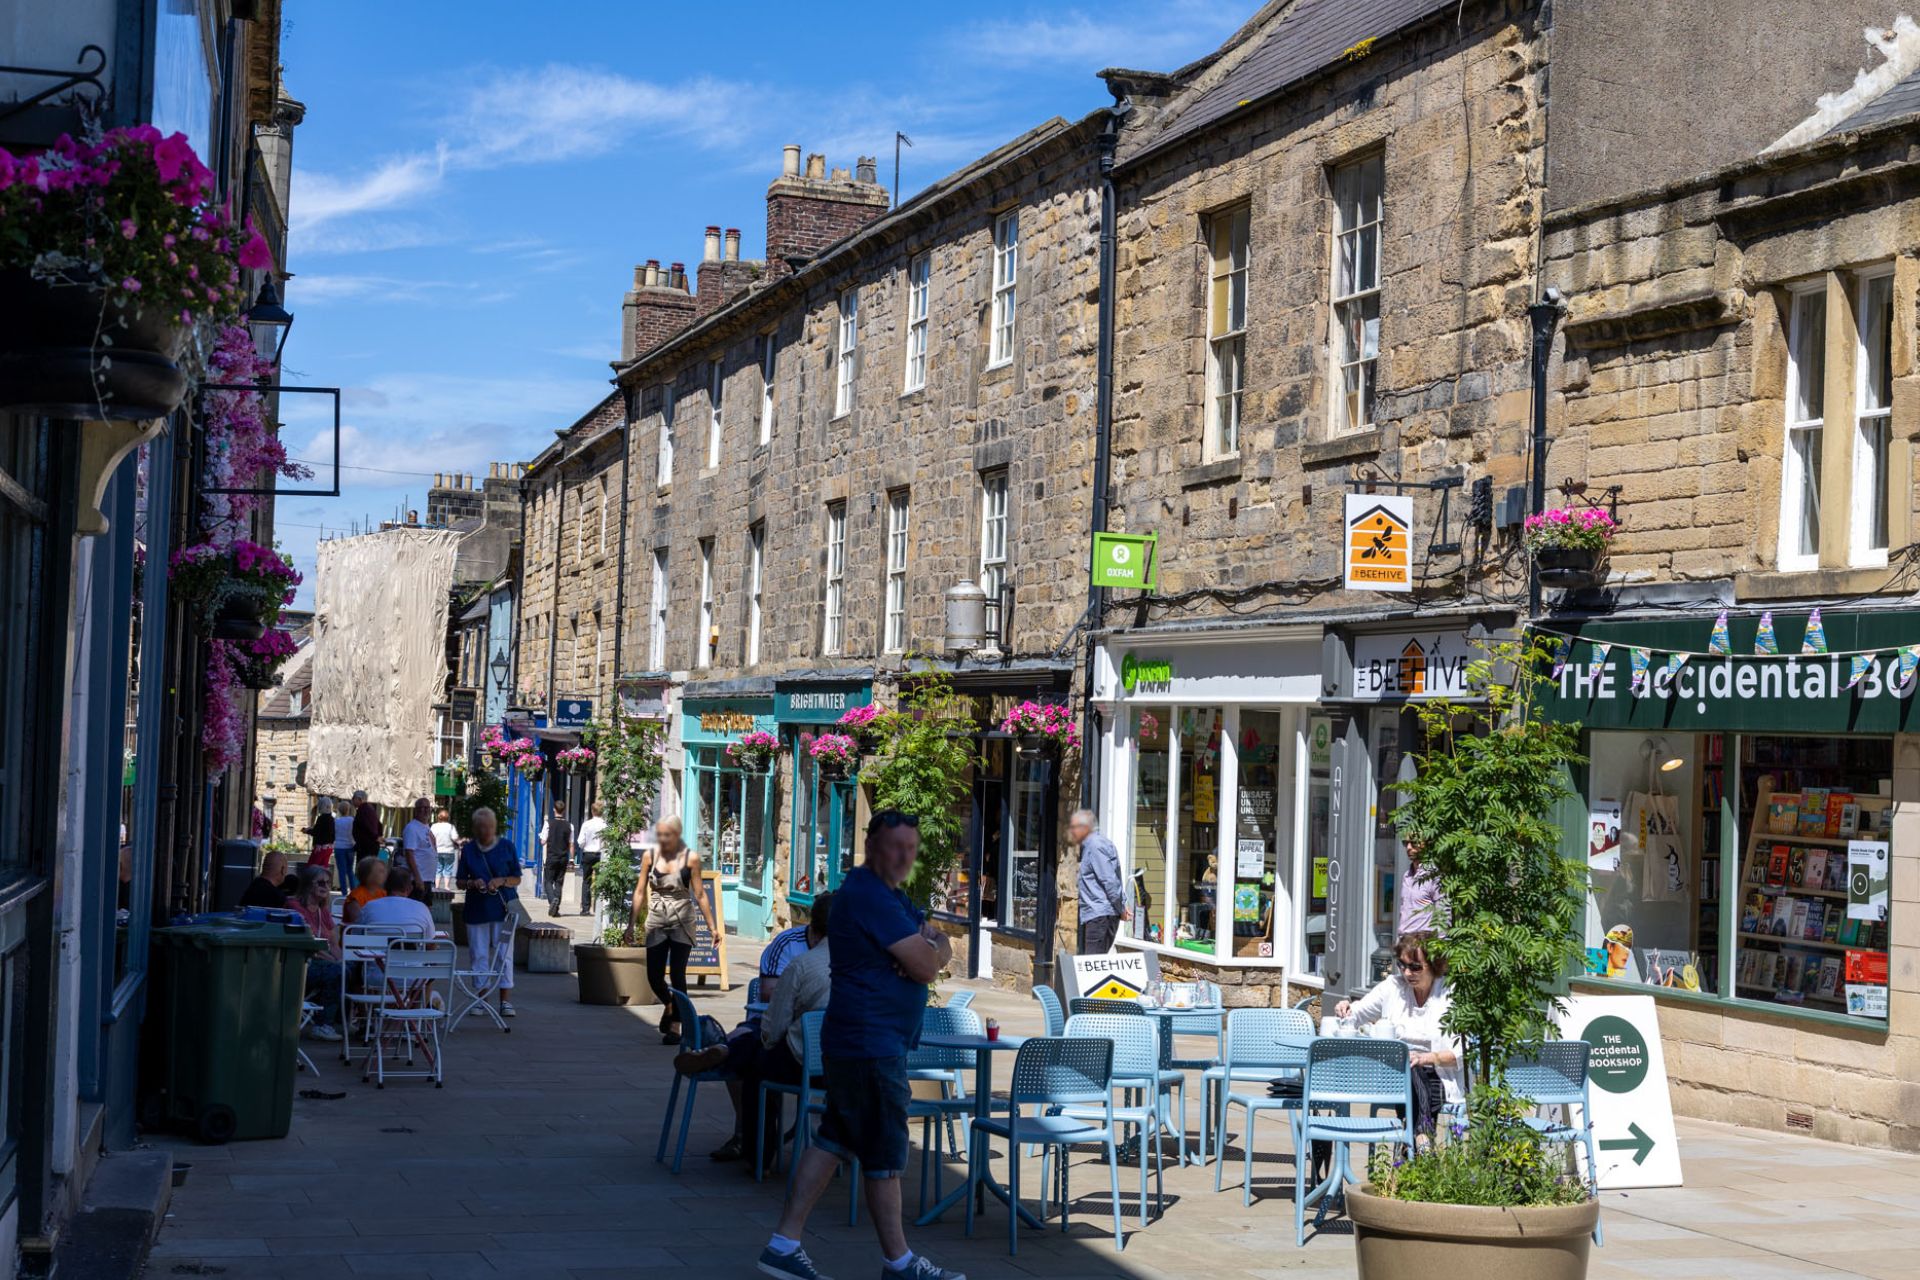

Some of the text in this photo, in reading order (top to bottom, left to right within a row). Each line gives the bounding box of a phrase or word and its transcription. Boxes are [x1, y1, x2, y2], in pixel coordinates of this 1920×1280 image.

[1106, 568, 1134, 578] OXFAM
[1360, 569, 1403, 580] BEEHIVE
[1358, 656, 1467, 692] THE BEEHIVE
[1560, 663, 1616, 698] THE
[1631, 653, 1839, 714] accidental
[790, 693, 845, 709] BRIGHTWATER
[1241, 790, 1273, 799] UNSAFE.
[1241, 798, 1273, 807] UNJUST.
[1240, 807, 1273, 815] UNSEEN.
[1240, 845, 1263, 853] APPEAL
[1328, 766, 1342, 952] ANTIQUES
[1084, 958, 1143, 972] BEEHIVE
[1603, 1035, 1621, 1043] THE
[1589, 1058, 1642, 1067] BOOKSHOP
